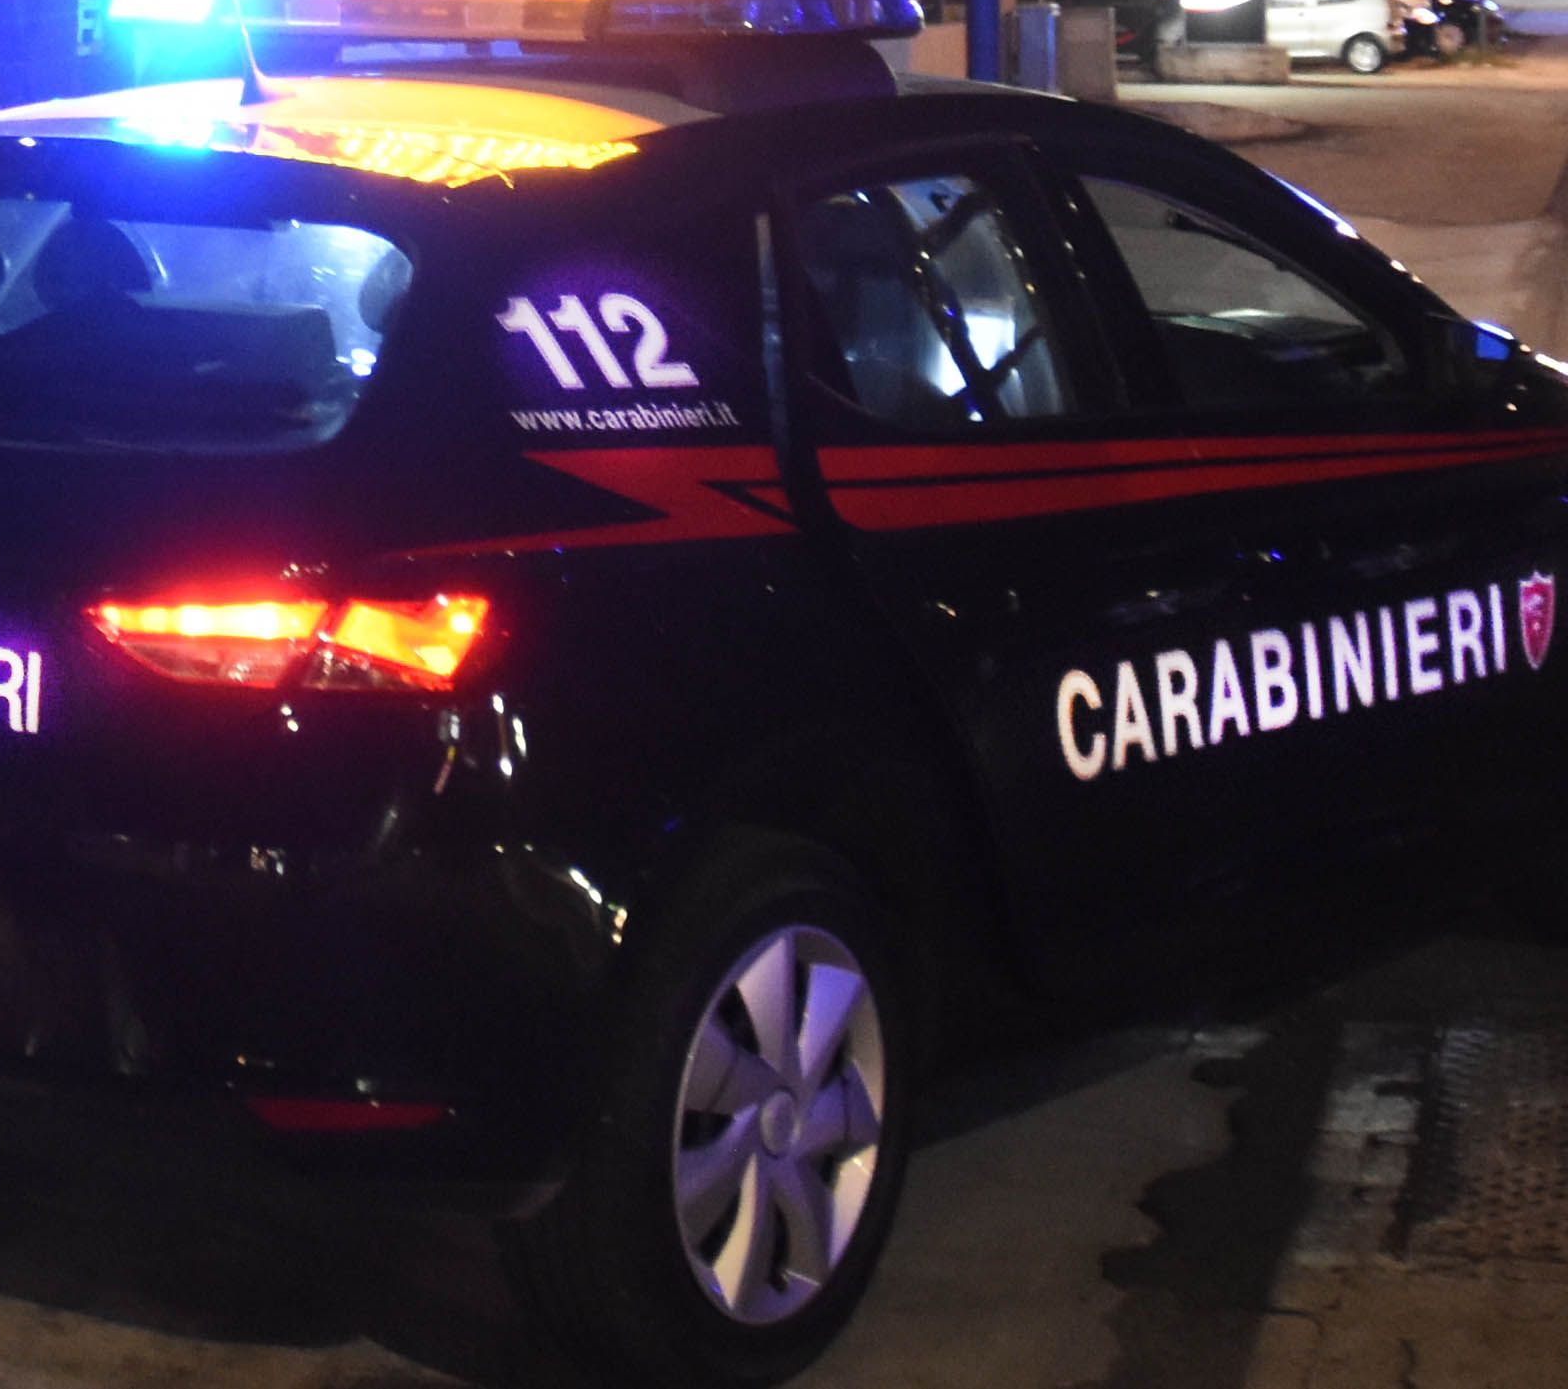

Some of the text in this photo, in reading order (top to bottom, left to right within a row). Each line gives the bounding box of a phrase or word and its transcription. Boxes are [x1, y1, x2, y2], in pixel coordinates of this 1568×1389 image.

[495, 292, 700, 389] 112
[511, 400, 742, 432] www.carabinieri.it
[1056, 582, 1506, 782] CARABINIERI
